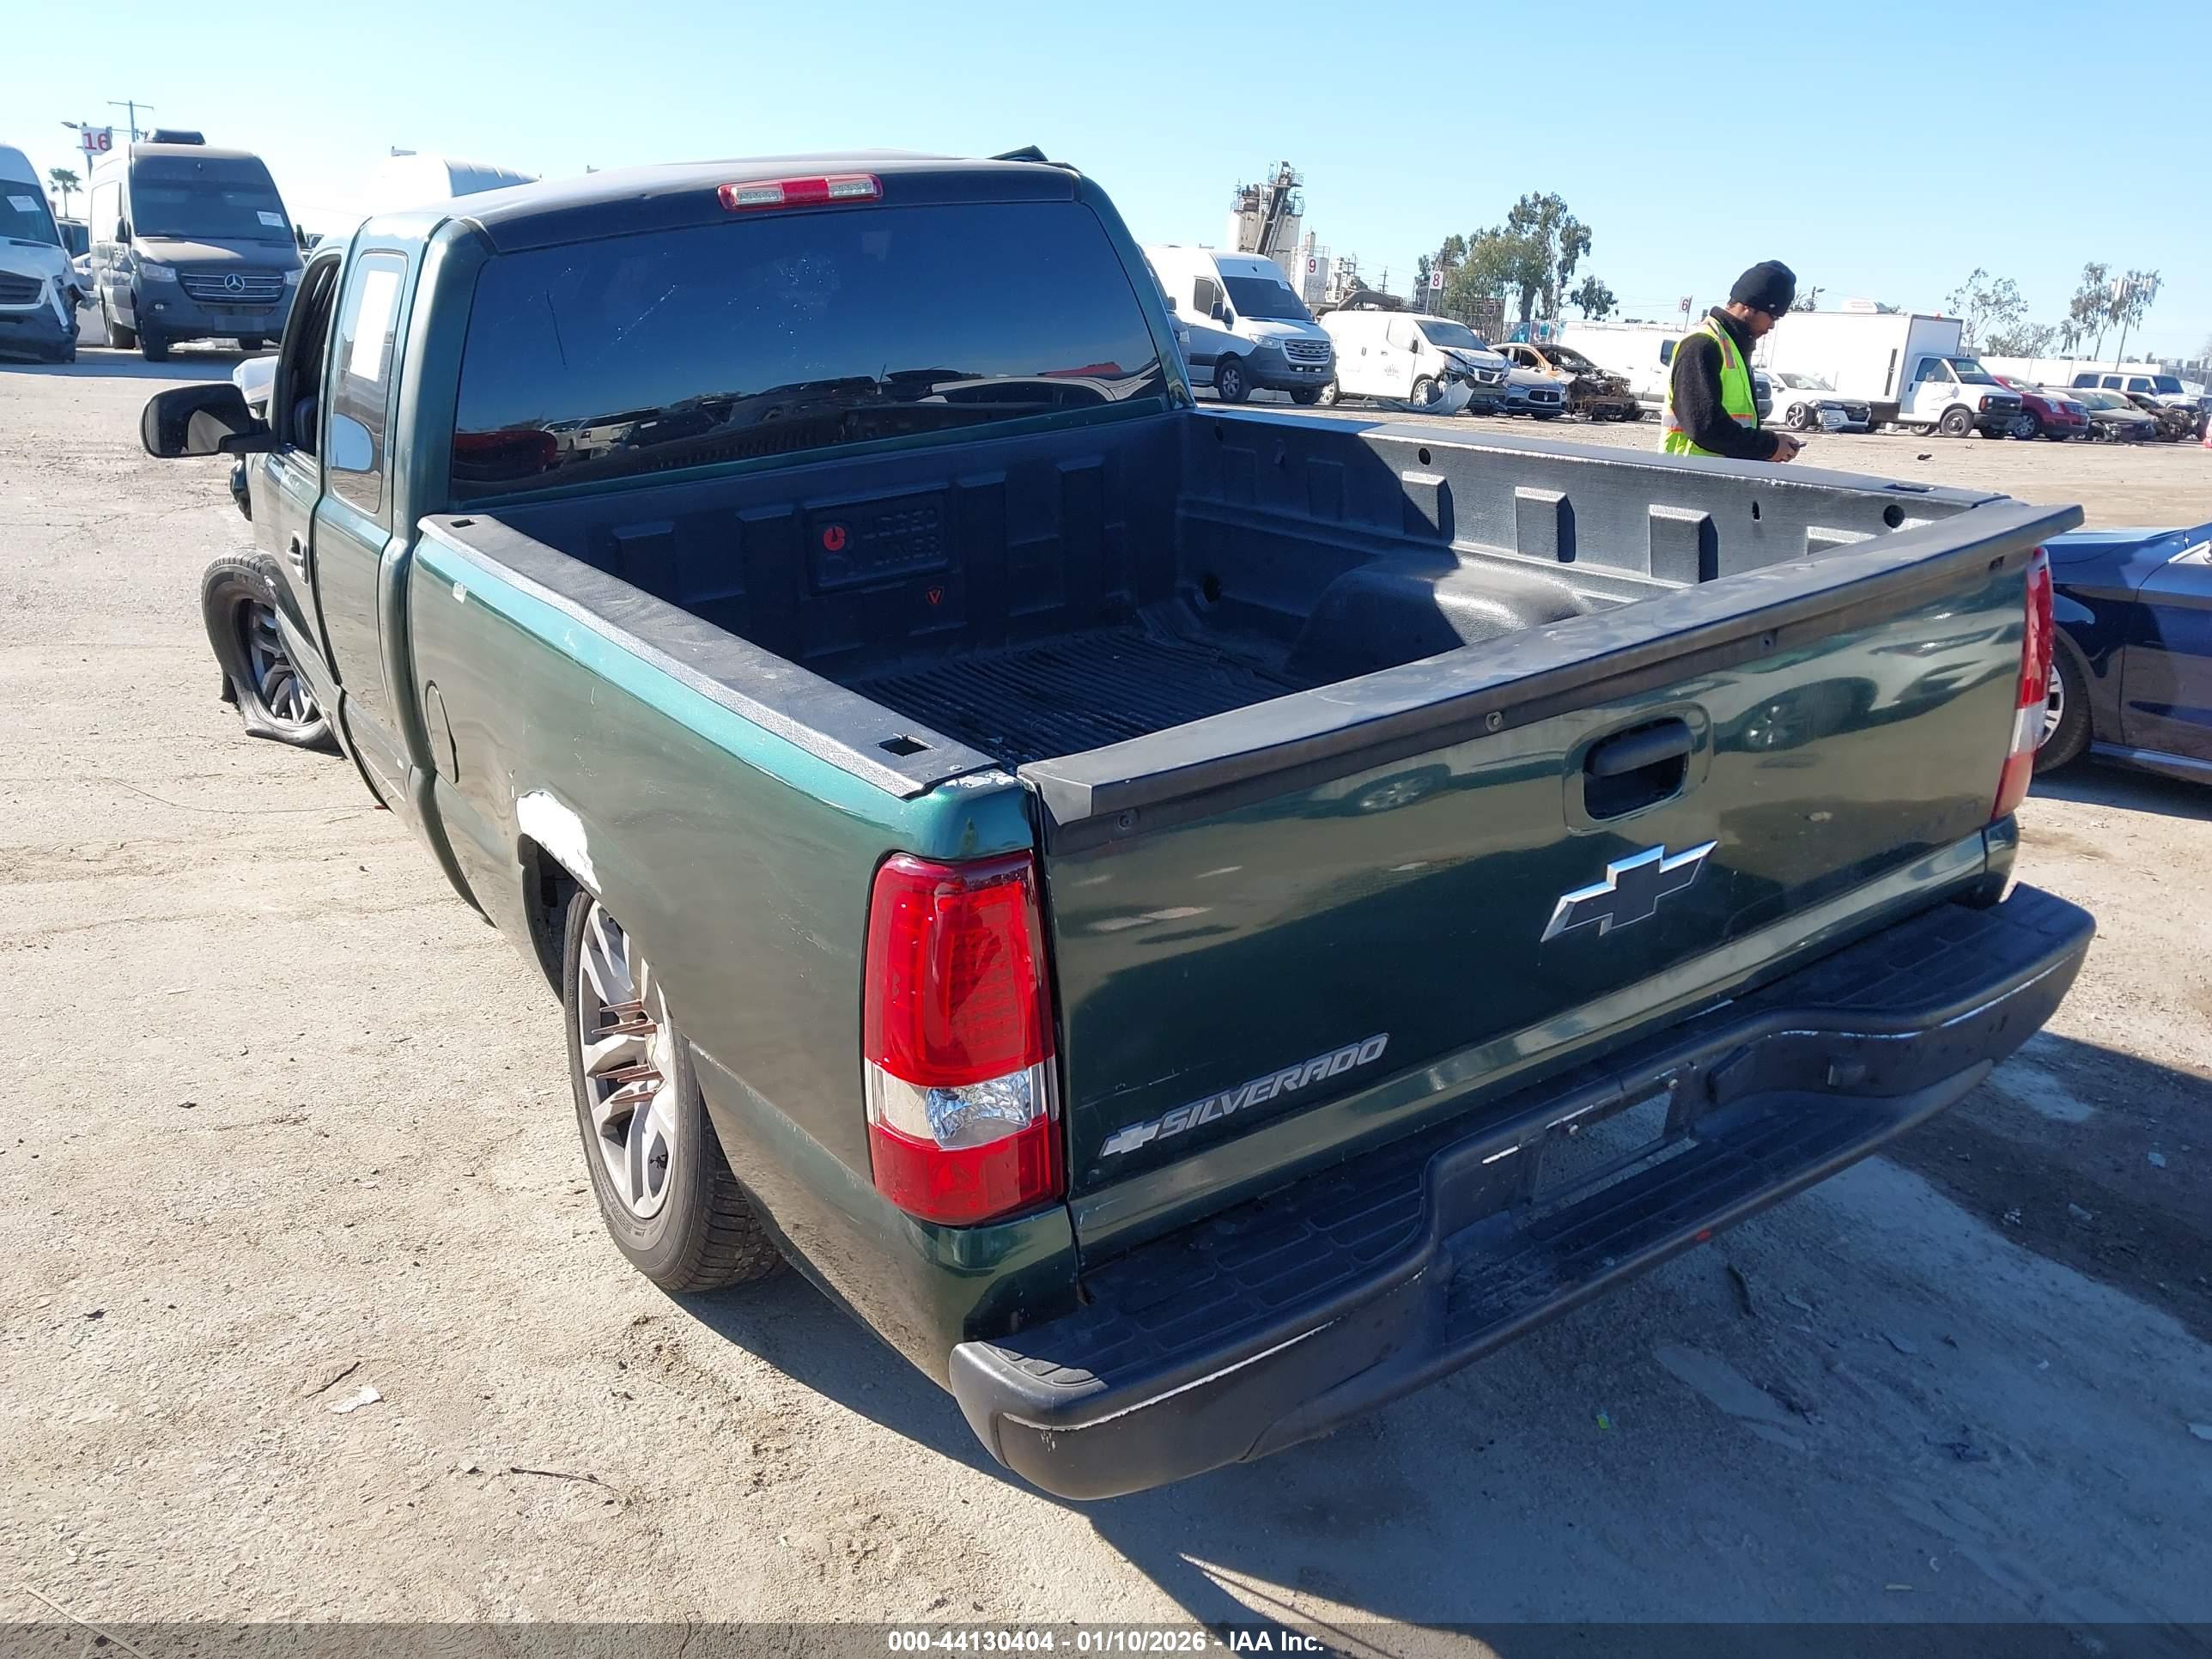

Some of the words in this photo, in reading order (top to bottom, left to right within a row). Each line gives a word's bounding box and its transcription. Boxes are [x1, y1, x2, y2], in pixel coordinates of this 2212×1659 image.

[82, 132, 112, 152] 16
[1309, 258, 1316, 273] 9
[1432, 272, 1440, 287] 8
[1681, 298, 1689, 311] 6
[1157, 1032, 1389, 1139] SILVERADO
